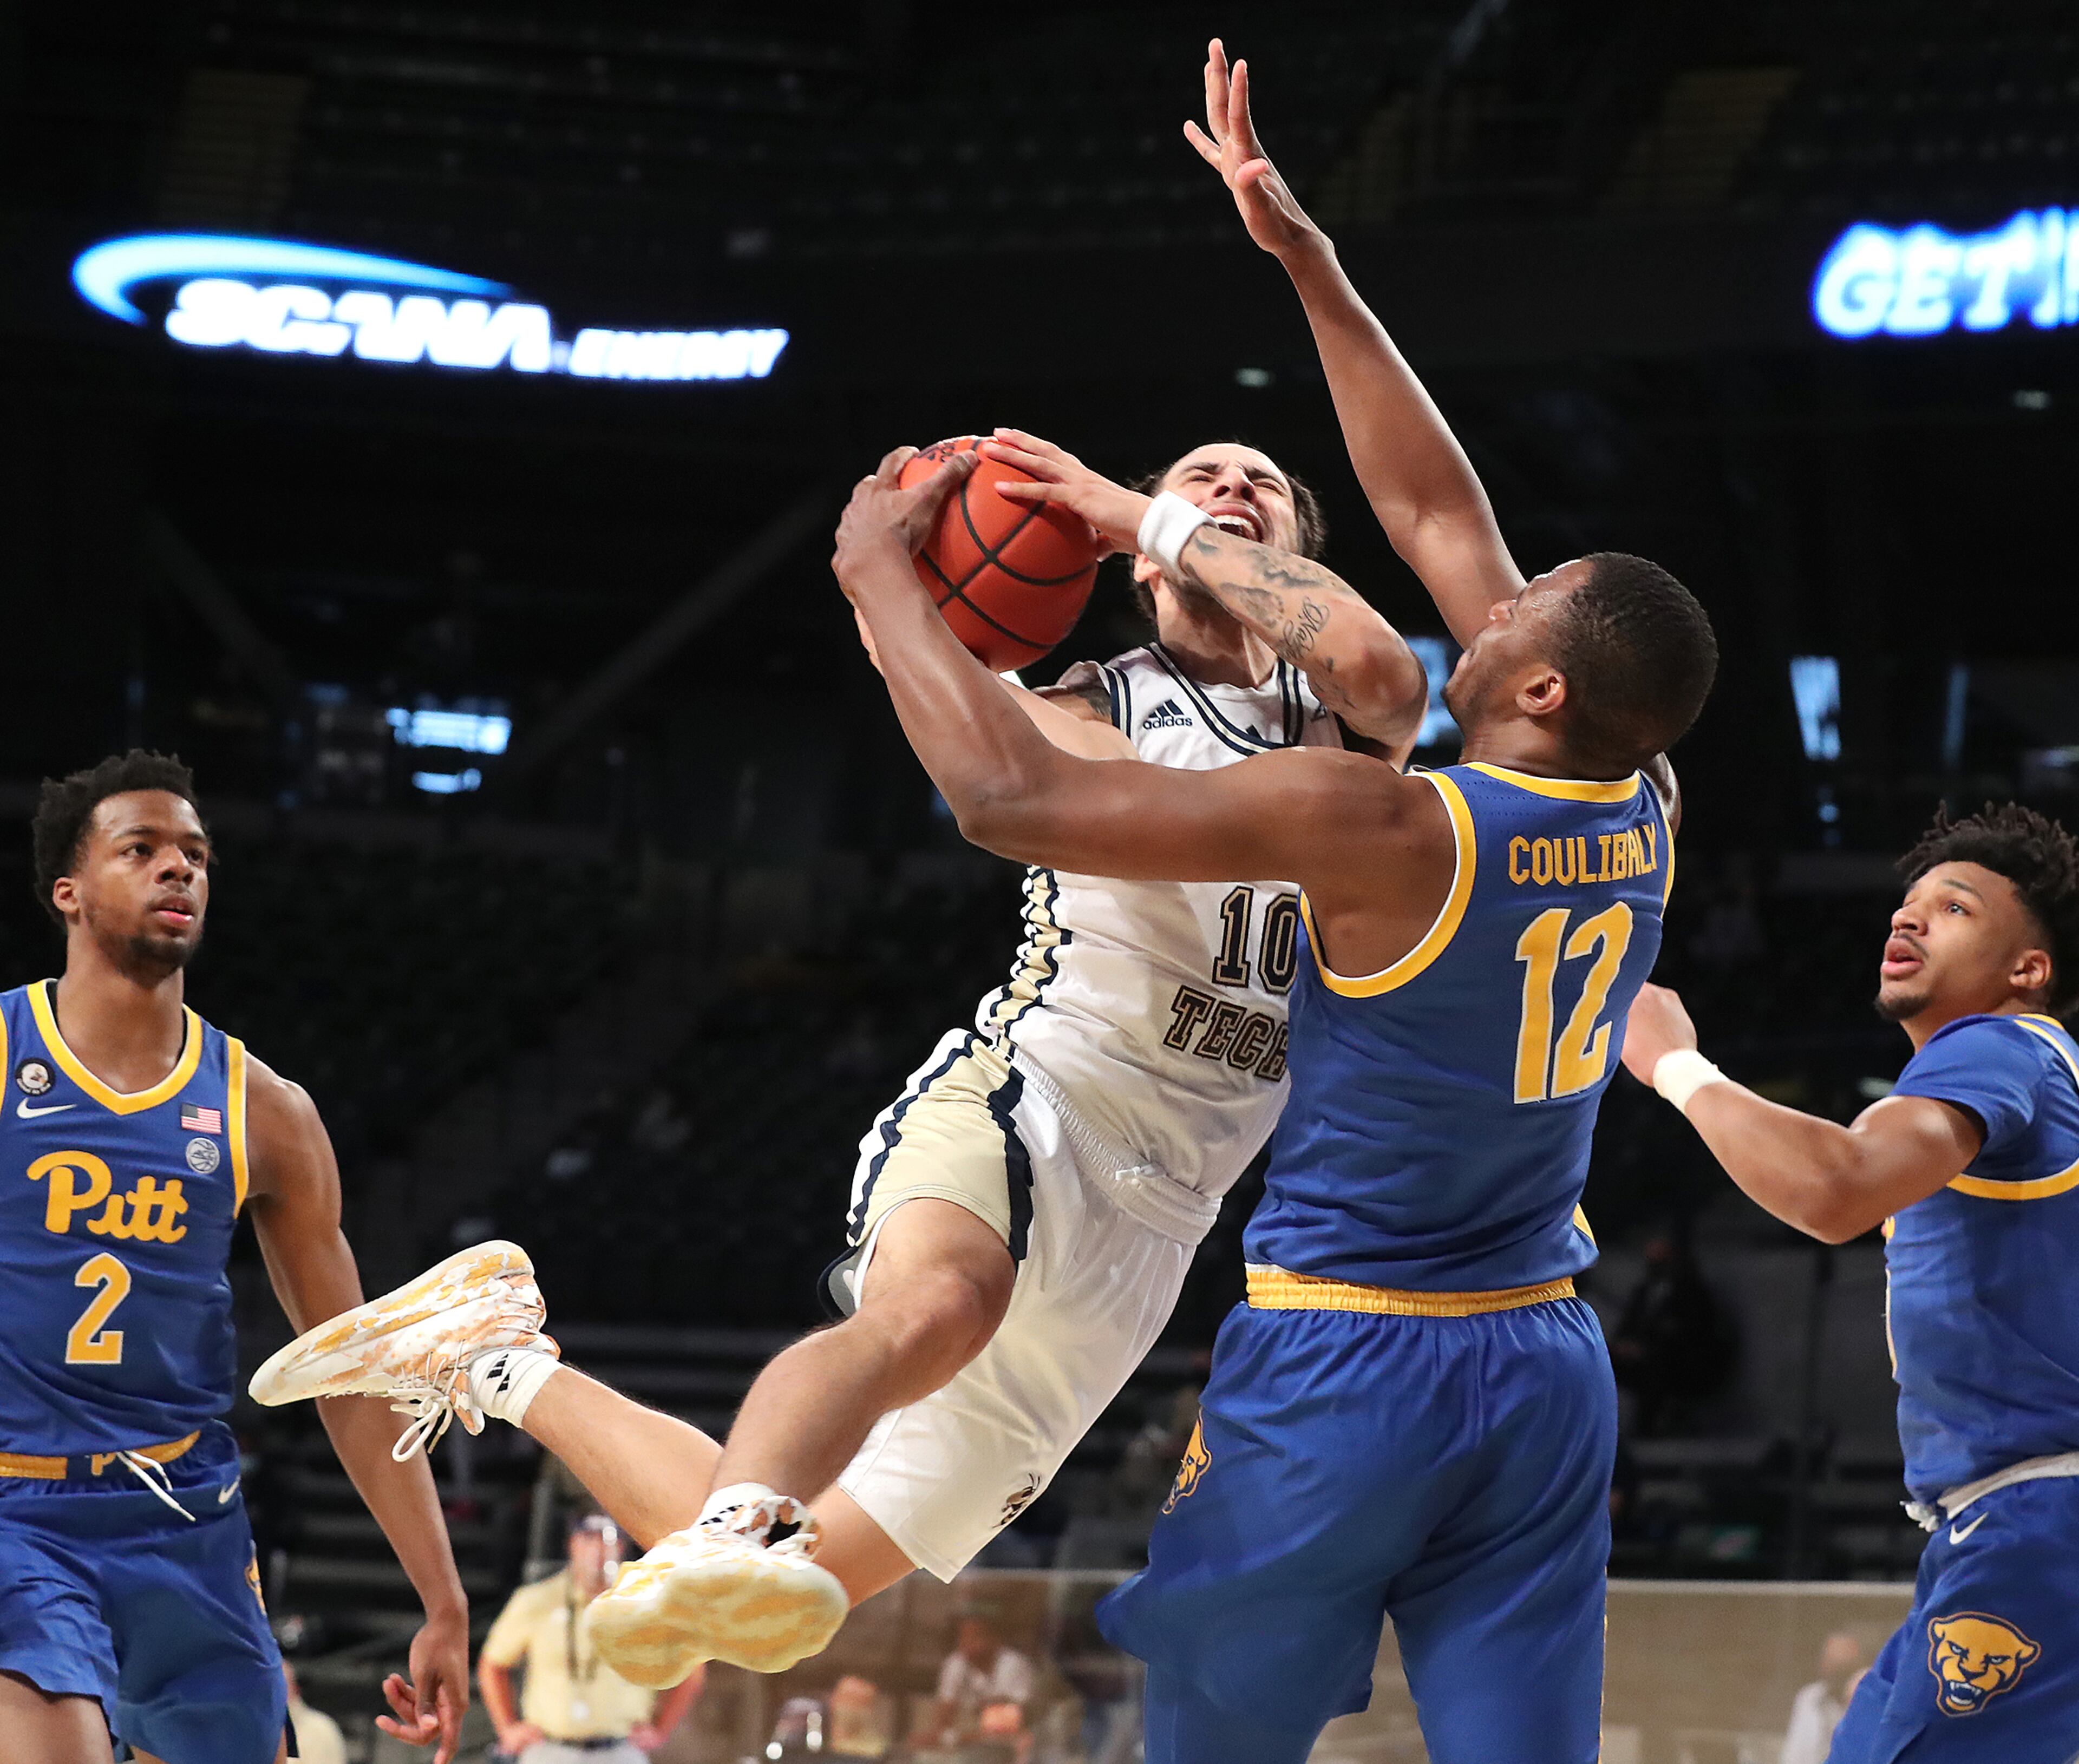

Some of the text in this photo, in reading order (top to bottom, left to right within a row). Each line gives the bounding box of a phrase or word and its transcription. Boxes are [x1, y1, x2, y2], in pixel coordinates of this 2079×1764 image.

[165, 278, 552, 373] SCANA
[1816, 222, 2033, 337] GET
[1142, 714, 1193, 730] adidas
[1508, 822, 1657, 886] COULIBALY
[1212, 886, 1299, 995] 10
[1513, 900, 1633, 1105] 12
[26, 1150, 189, 1243] Pitt
[65, 1252, 132, 1365] 2
